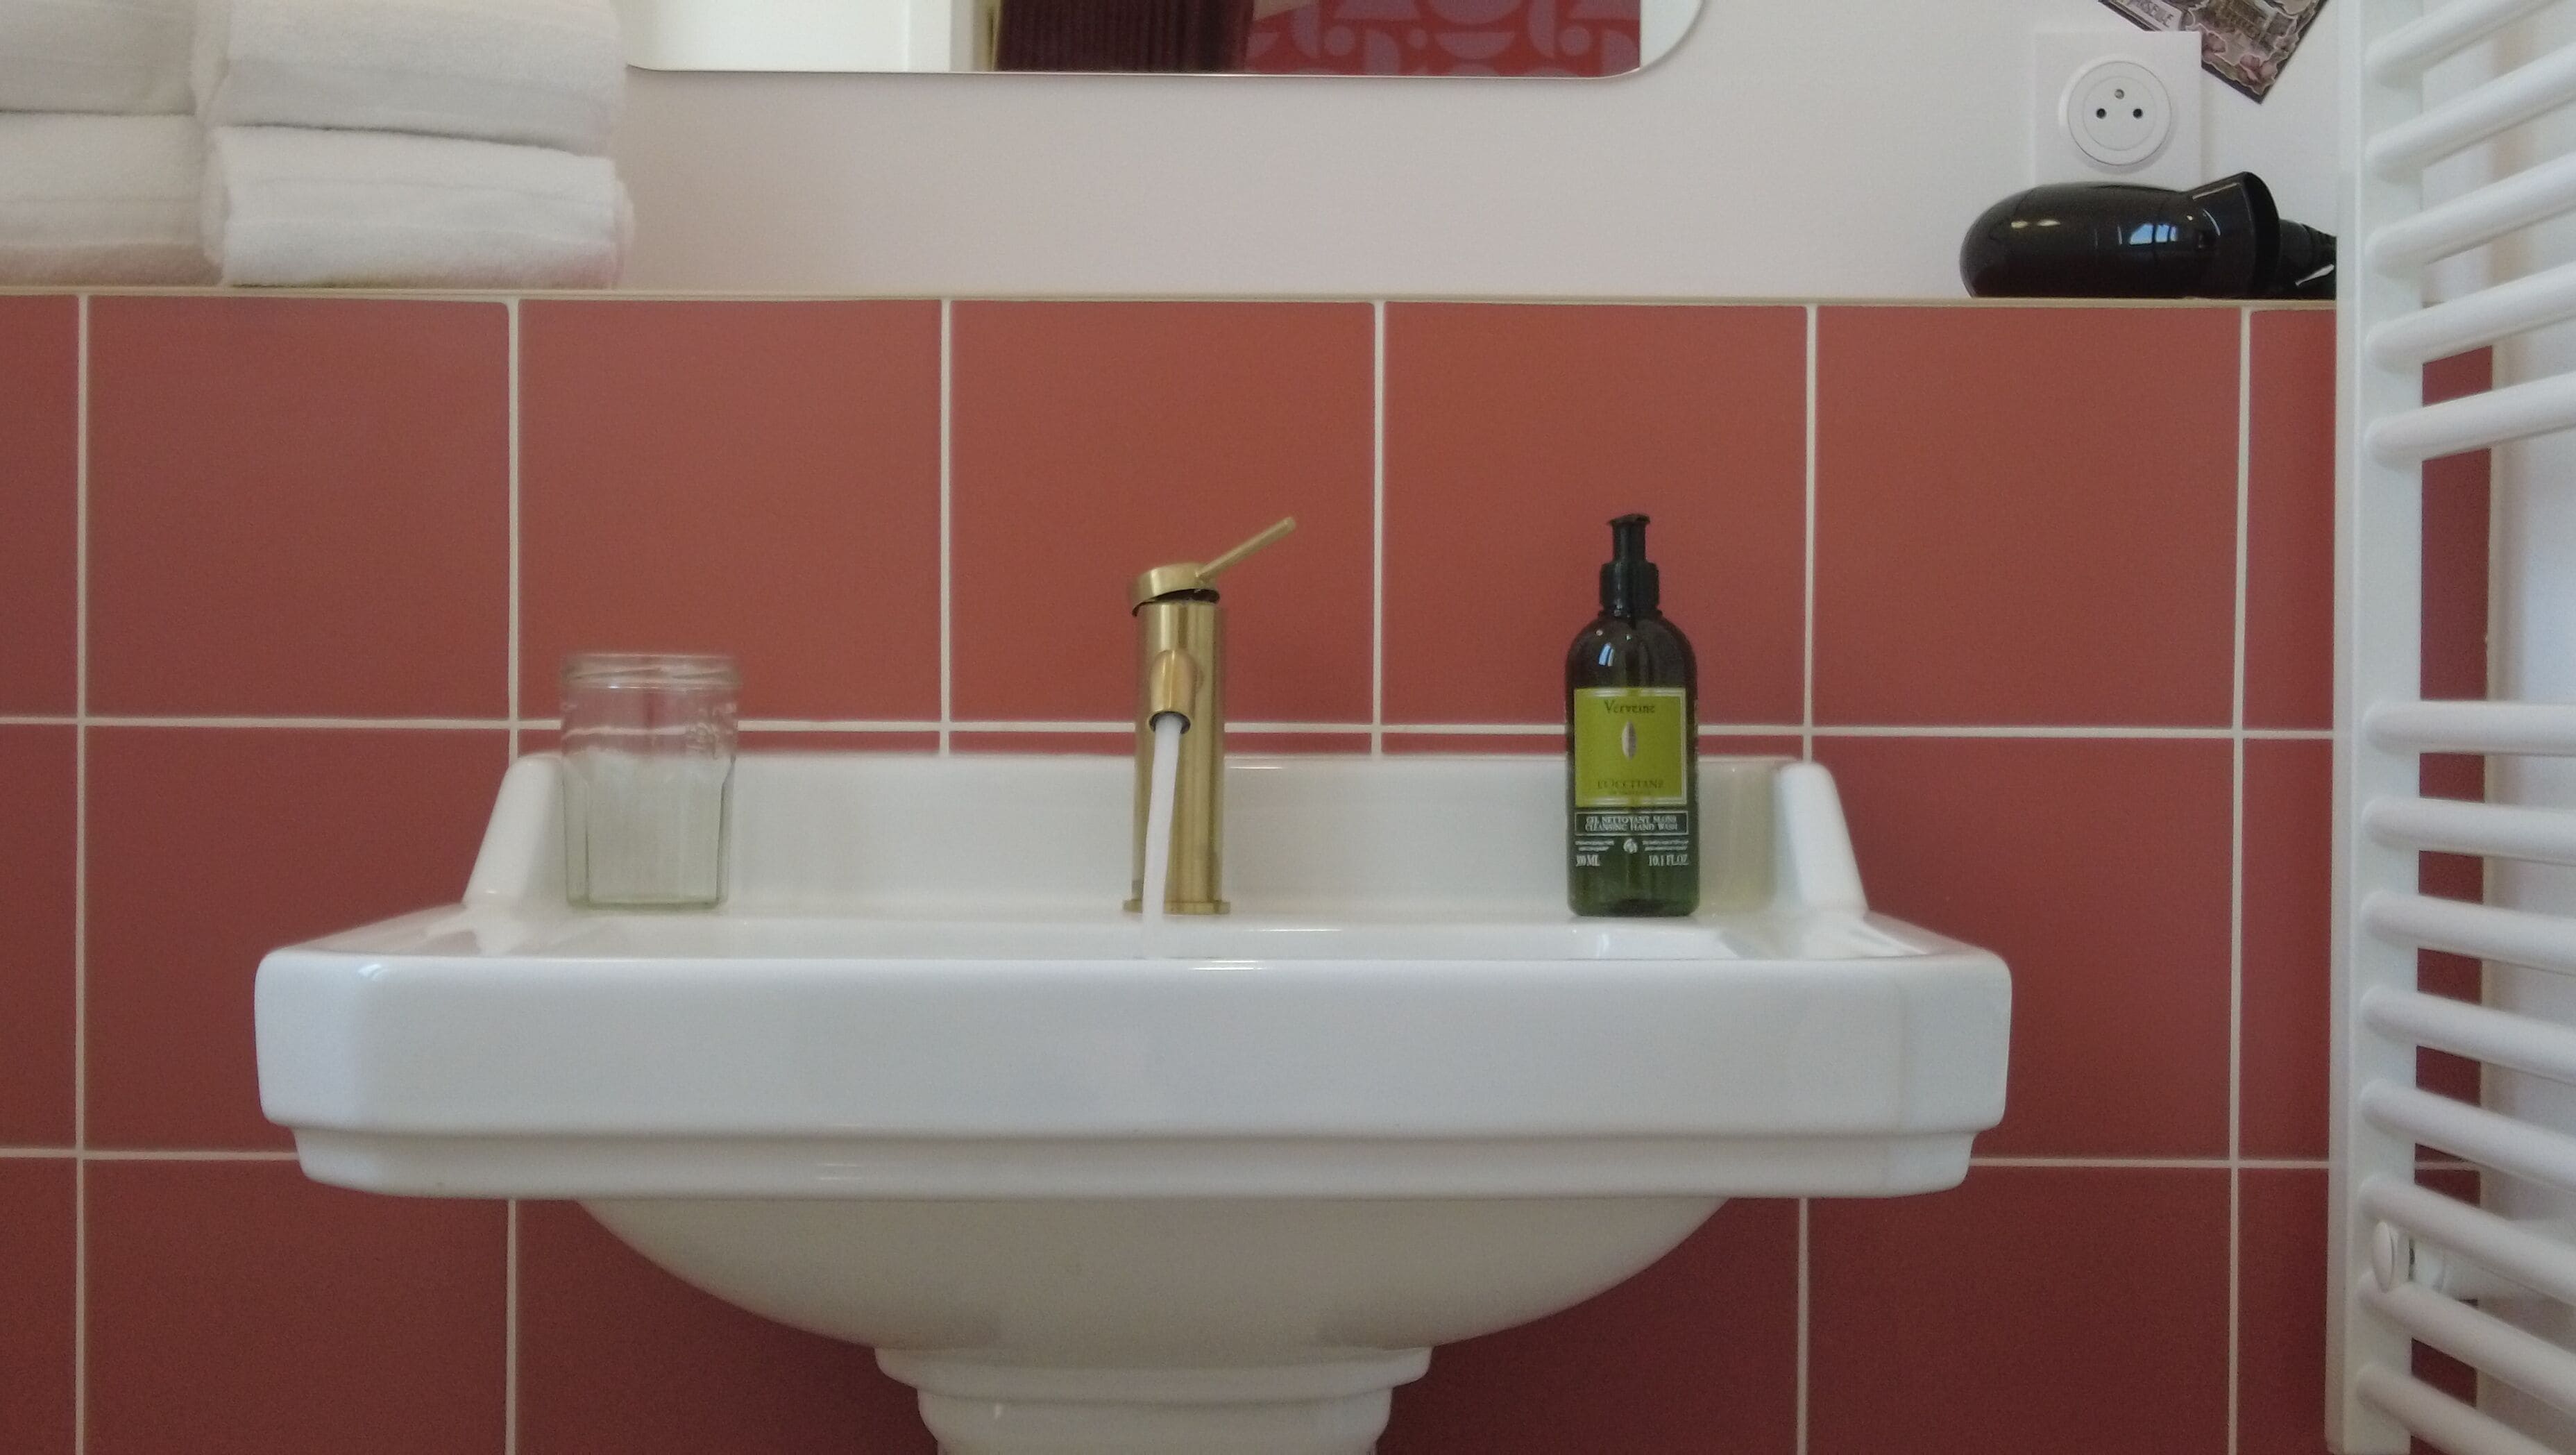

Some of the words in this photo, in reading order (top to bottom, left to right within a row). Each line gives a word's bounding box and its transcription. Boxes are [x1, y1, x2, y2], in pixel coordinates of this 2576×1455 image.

[1604, 699, 1655, 714] Verveine
[1587, 855, 1600, 866] ML
[1649, 855, 1664, 867] 10.1
